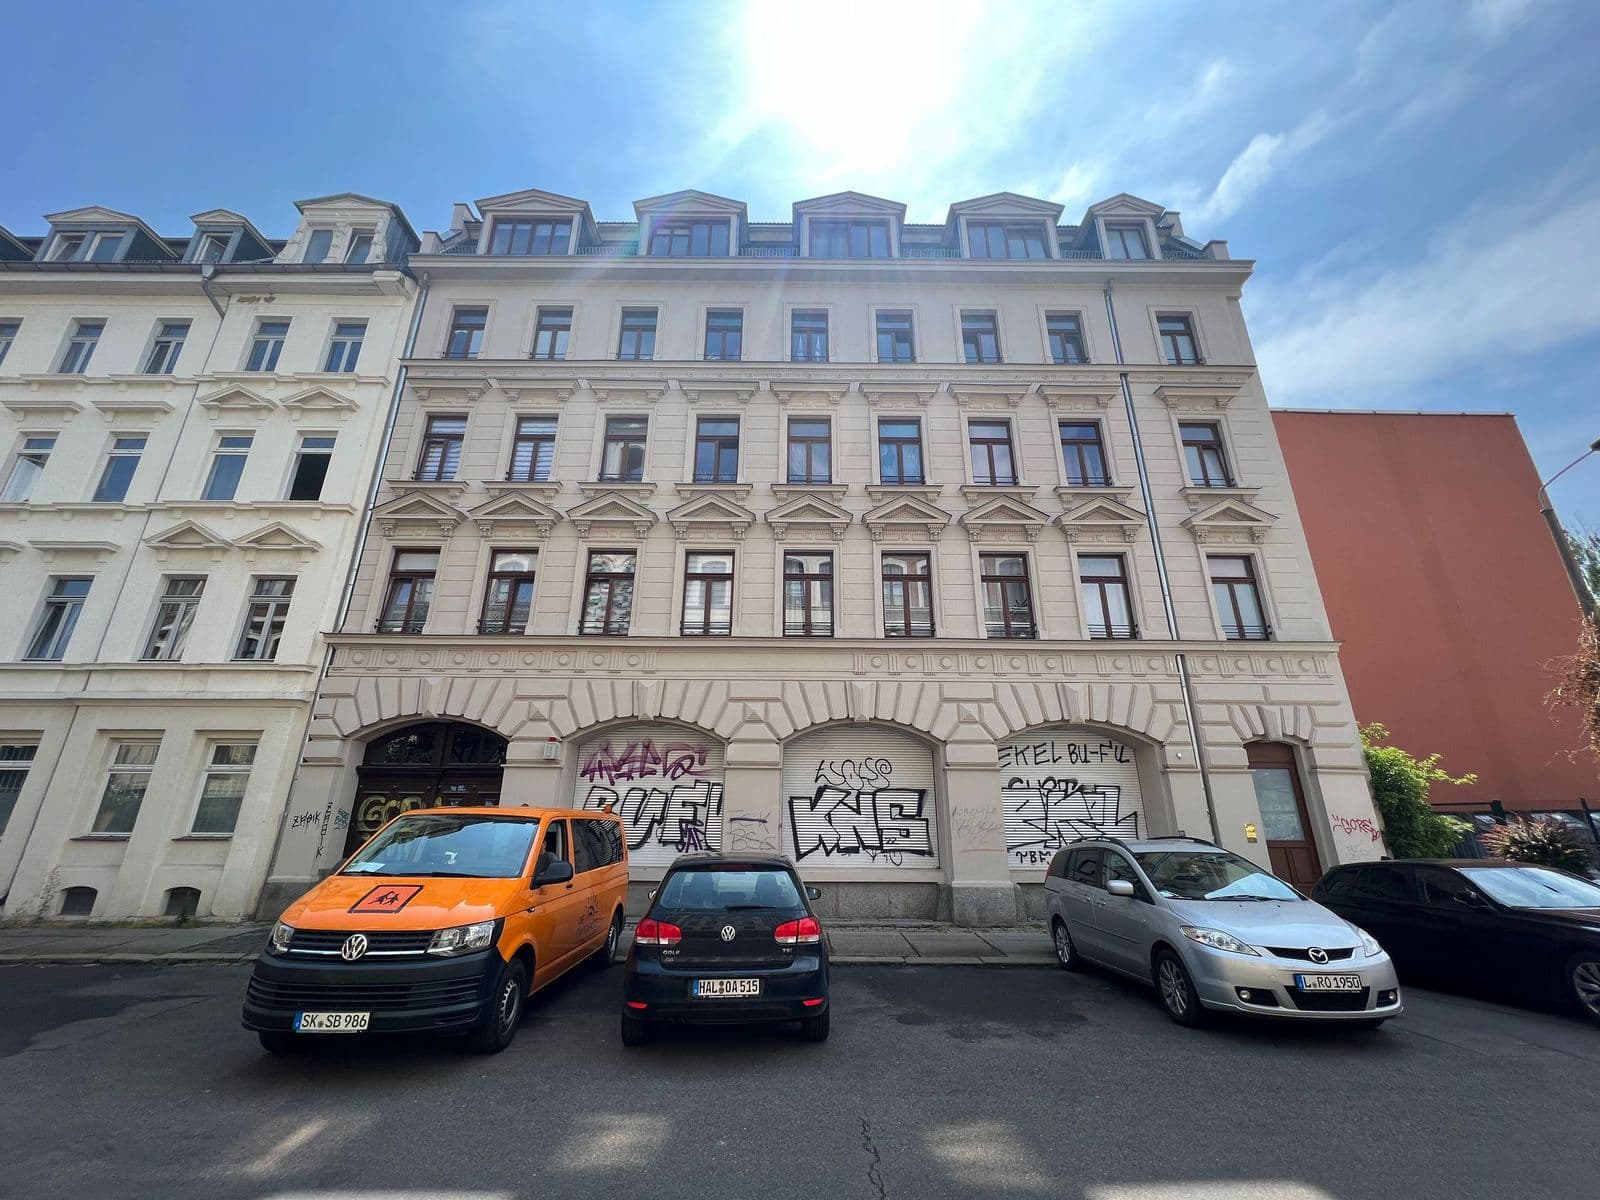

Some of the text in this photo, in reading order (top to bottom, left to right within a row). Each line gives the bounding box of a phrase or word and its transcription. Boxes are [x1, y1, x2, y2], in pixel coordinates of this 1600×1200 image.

[998, 741, 1062, 768] EKEL
[699, 981, 718, 994] HAL
[740, 980, 758, 993] 515
[1302, 976, 1312, 988] L
[1332, 976, 1360, 989] 1950
[301, 1014, 368, 1029] SK SB 986
